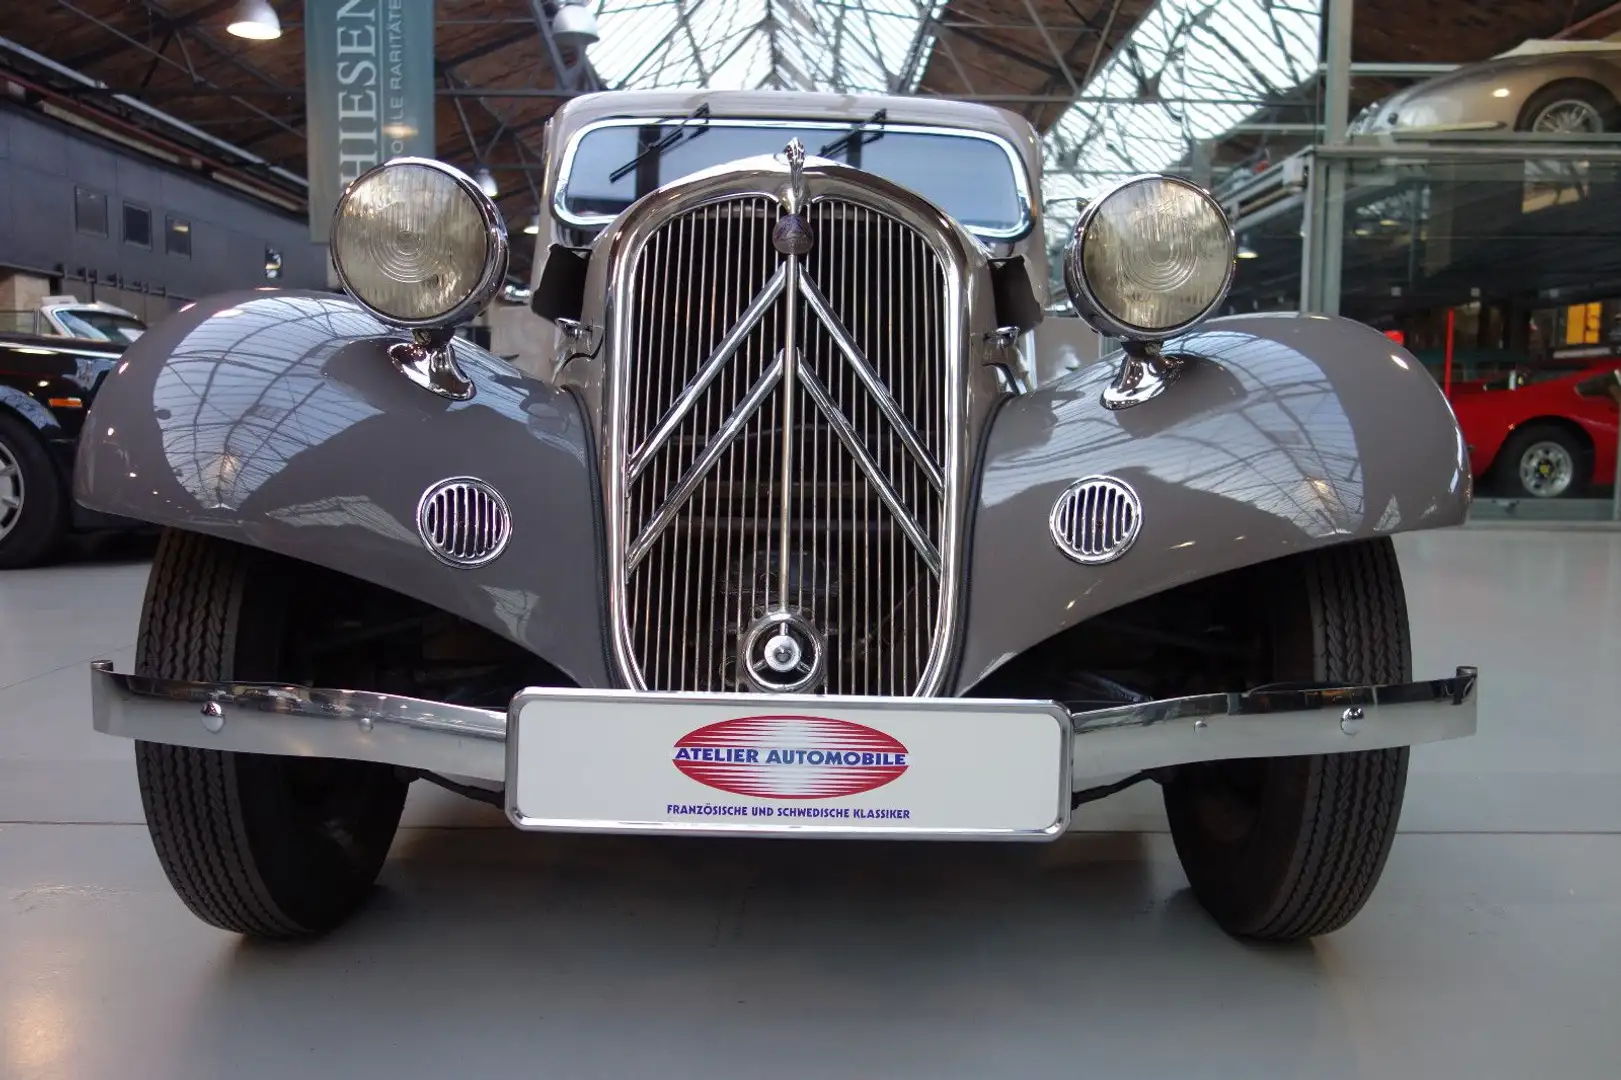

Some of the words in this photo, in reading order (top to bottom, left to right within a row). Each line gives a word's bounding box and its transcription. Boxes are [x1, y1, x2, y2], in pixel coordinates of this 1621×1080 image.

[675, 747, 759, 763] ATELIER
[765, 749, 906, 766] AUTOMOBILE
[667, 803, 748, 816] FRANZÖSISCHE
[751, 806, 774, 817] UND
[777, 807, 850, 818] SCHWEDISCHE
[853, 808, 910, 819] KLASSIKER
